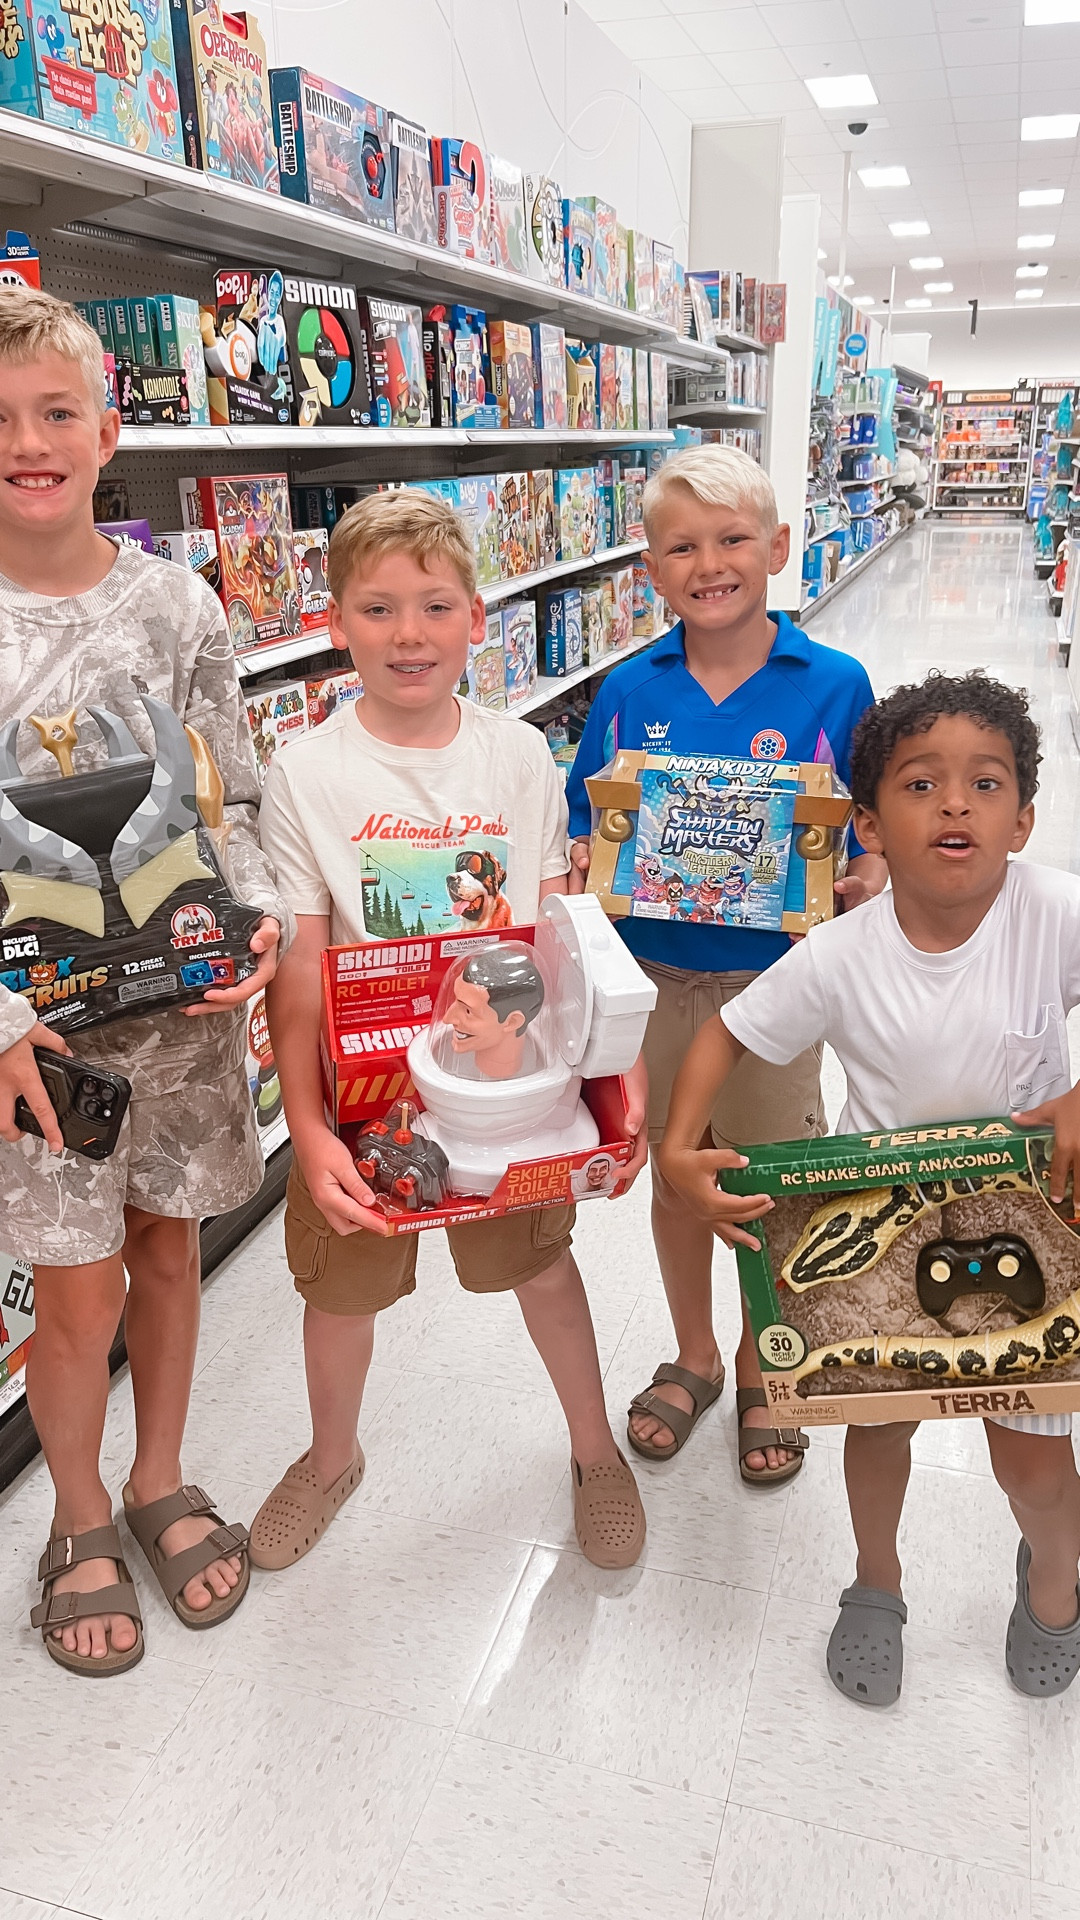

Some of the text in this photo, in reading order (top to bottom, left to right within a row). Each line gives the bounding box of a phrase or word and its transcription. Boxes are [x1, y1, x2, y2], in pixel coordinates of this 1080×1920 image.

[200, 24, 262, 77] OPERATION
[305, 86, 352, 131] BATTLESHIP
[280, 104, 297, 174] BATTLESHIP
[397, 124, 428, 153] BATTLESHIP
[7, 246, 17, 256] 3D
[216, 274, 239, 297] bop
[142, 376, 181, 400] KANOODLE
[221, 523, 244, 535] ACADEMY
[305, 598, 328, 615] GUESS
[276, 690, 300, 704] SUPER
[274, 698, 304, 719] MARIO
[276, 715, 304, 733] CHESS
[666, 756, 777, 778] NINJA KIDZ!
[350, 813, 508, 842] National Park
[669, 808, 761, 834] SHADOW
[412, 840, 465, 849] RESCUE TEAM
[663, 828, 759, 853] MASTERS
[684, 851, 737, 867] MYSTERY
[758, 856, 774, 867] 17
[688, 862, 730, 876] CHEST
[3, 934, 37, 946] INCLUDES
[172, 929, 223, 949] TRY ME
[456, 938, 490, 947] WARNING
[4, 941, 40, 960] DLC!
[188, 950, 222, 960] INCLUDES:
[337, 942, 432, 971] SKIBIDI
[122, 957, 164, 975] 12 GREAT
[140, 962, 166, 972] ITEMS!
[394, 964, 429, 974] TOILET
[17, 966, 109, 1008] FRUITS
[136, 976, 174, 988] WARNING:
[336, 976, 430, 998] RC TOILET
[57, 1001, 81, 1013] DRAGON
[64, 1004, 86, 1016] BUNDLE
[861, 1122, 1014, 1149] TERRA
[508, 1161, 574, 1184] SKIBIDI
[780, 1150, 1014, 1186] RC SNAKE: GIANT ANACONDA
[508, 1174, 569, 1197] TOILET
[506, 1186, 568, 1206] DELUXE RC
[507, 1197, 566, 1212] JUMPSCARE ACTION!
[397, 1208, 498, 1232] SKIBIDI TOILET
[15, 1259, 22, 1267] AS
[770, 1338, 792, 1352] 30
[768, 1380, 790, 1392] 5+
[772, 1392, 790, 1402] yrs
[930, 1390, 1036, 1414] TERRA
[790, 1407, 836, 1415] WARNING
